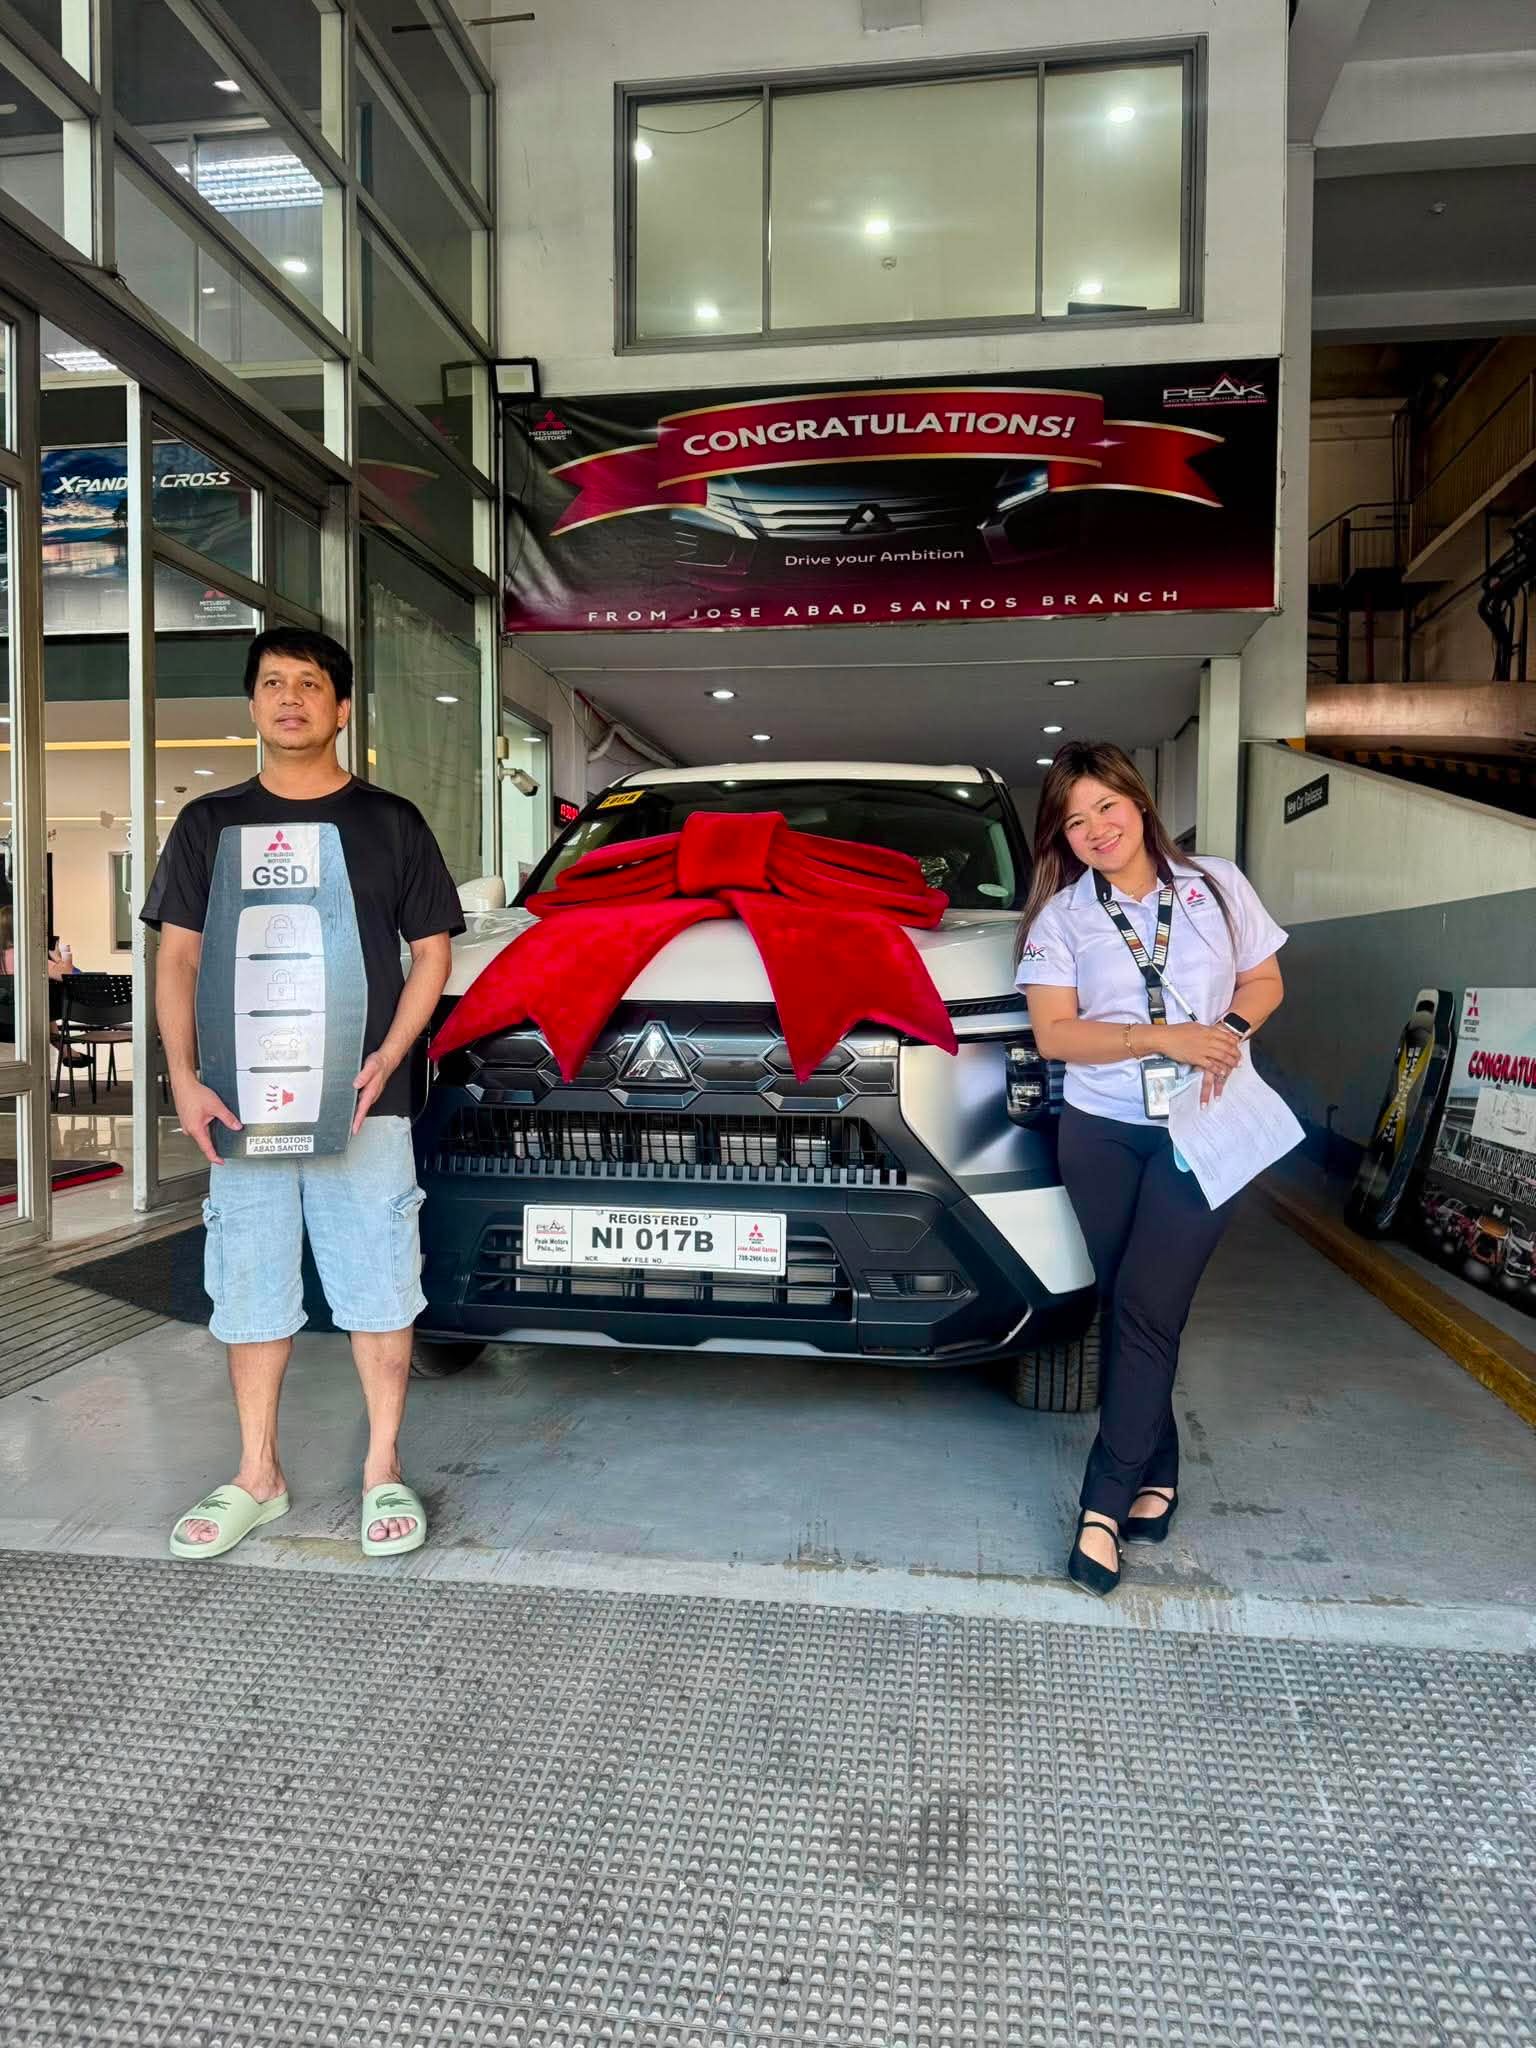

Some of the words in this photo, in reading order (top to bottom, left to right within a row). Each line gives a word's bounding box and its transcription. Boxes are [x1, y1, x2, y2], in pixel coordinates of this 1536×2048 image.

[1163, 378, 1265, 400] PEAK
[683, 412, 1076, 456] CONGRATULATIONS!
[52, 474, 157, 494] XPAND
[160, 471, 231, 488] CROSS
[785, 555, 831, 566] Drive
[836, 554, 876, 567] your
[880, 549, 965, 562] Ambition
[588, 610, 666, 622] FROM
[689, 607, 761, 620] JOSE
[784, 603, 866, 617] ABAD
[890, 597, 1018, 613] SANTOS
[1043, 590, 1179, 608] BRANCH
[252, 865, 308, 886] GSD
[249, 1137, 273, 1145] PEAK
[275, 1136, 312, 1144] MOTORS
[277, 1144, 309, 1152] SANTOS
[609, 1213, 699, 1226] REGISTERED
[592, 1226, 623, 1249] NI
[635, 1228, 714, 1252] 017B
